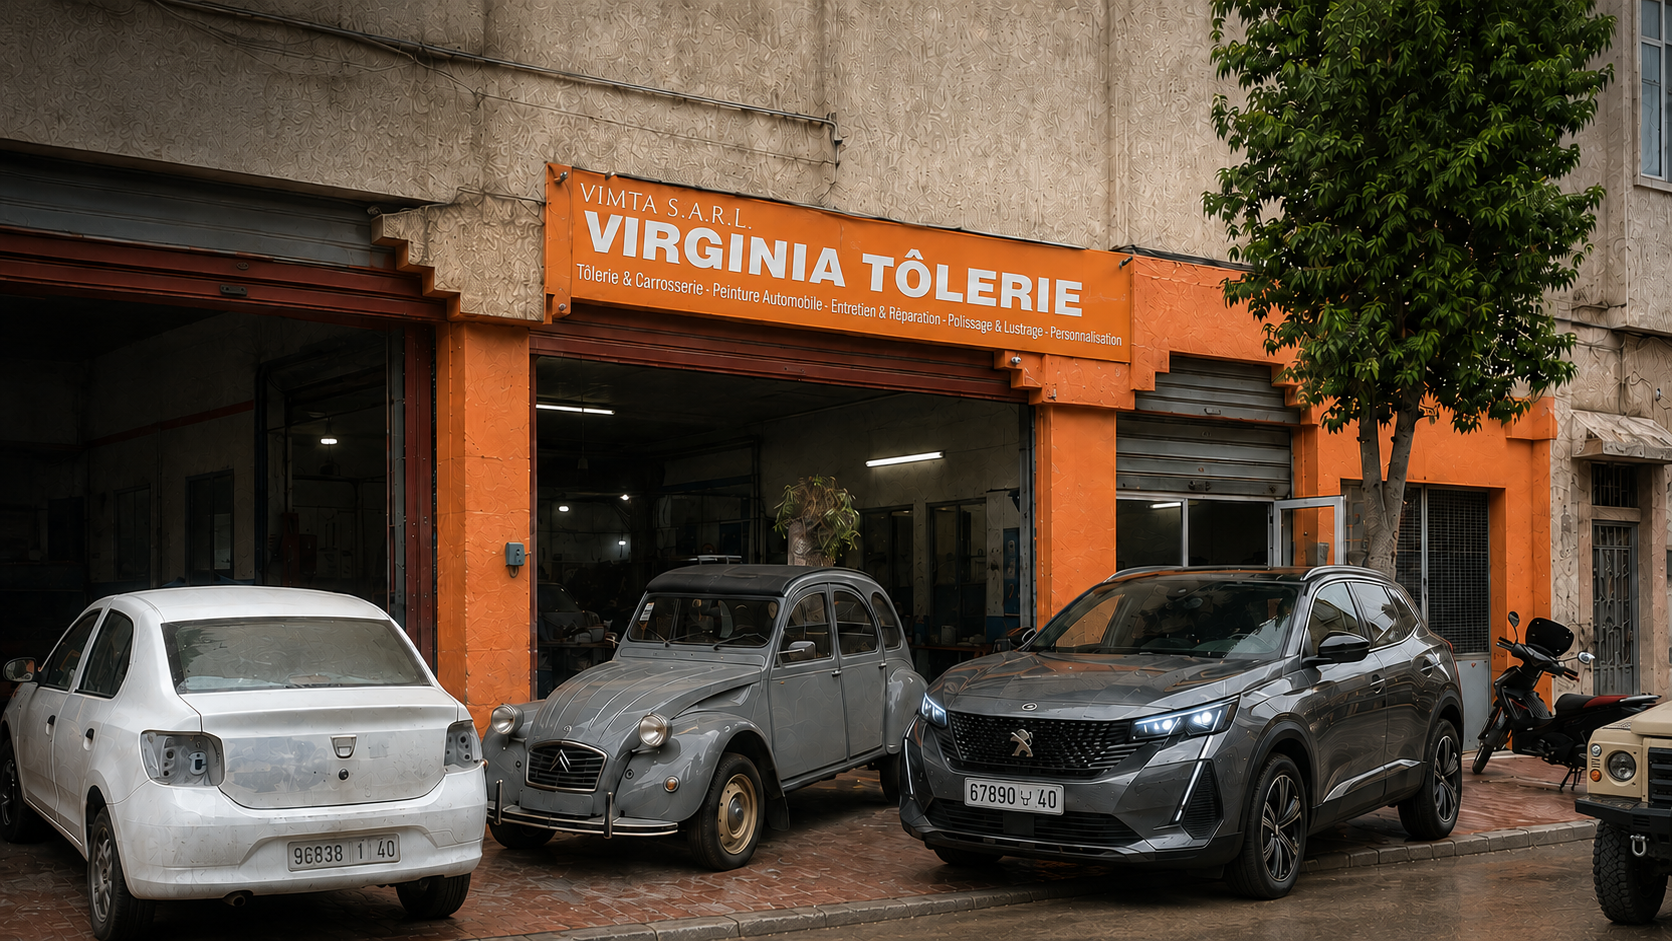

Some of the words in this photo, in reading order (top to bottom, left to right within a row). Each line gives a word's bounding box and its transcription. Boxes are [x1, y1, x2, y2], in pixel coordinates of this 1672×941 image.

[580, 183, 657, 214] VIMTA
[667, 198, 752, 230] S.A.R.L.
[584, 210, 846, 287] VIRGINIA
[862, 248, 1083, 317] TÔLERIE
[576, 263, 619, 285] Tôlerie
[622, 271, 632, 286] &
[635, 272, 703, 295] Carrosserie
[713, 282, 760, 303] Peinture
[762, 289, 823, 311] Automobile
[831, 298, 876, 318] Entretien
[878, 305, 886, 319] &
[948, 313, 993, 334] Polissage
[994, 319, 1002, 332] &
[1004, 320, 1044, 340] Lustrage
[1050, 325, 1122, 346] Personnalisation
[970, 783, 1016, 805] 67890
[1037, 789, 1057, 809] 40
[293, 844, 343, 865] 96838
[357, 842, 364, 859] 1
[377, 839, 395, 858] 40
